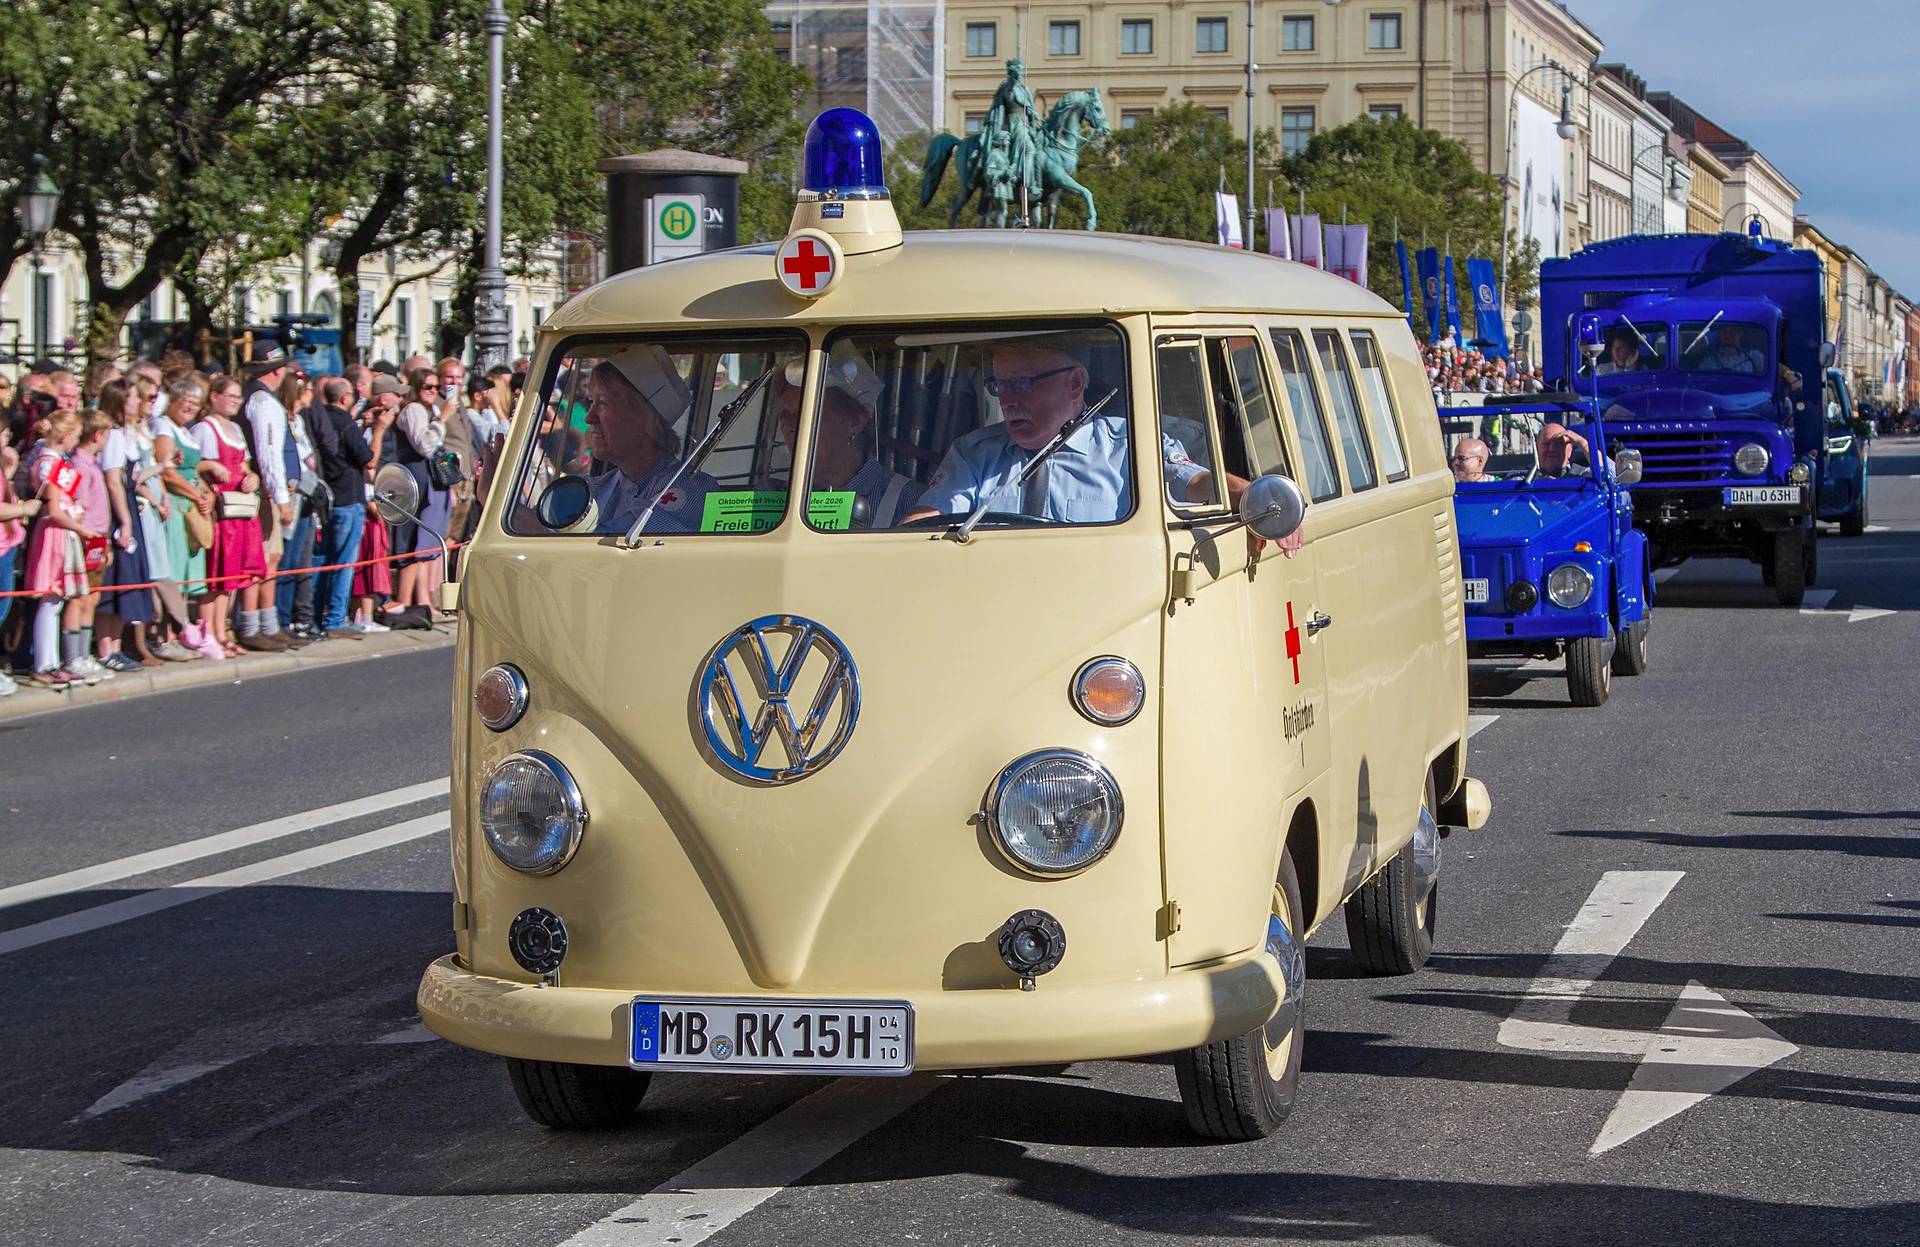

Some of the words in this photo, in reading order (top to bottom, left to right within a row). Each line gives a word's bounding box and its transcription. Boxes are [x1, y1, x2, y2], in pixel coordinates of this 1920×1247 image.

[670, 210, 685, 231] H
[718, 497, 762, 505] Oktoberfest
[1732, 490, 1753, 502] DAH
[1770, 489, 1791, 502] 63H
[713, 519, 749, 532] Freie
[1465, 582, 1475, 600] H
[880, 1016, 898, 1028] 04
[660, 1011, 708, 1055] MB
[736, 1012, 785, 1058] RK
[793, 1014, 871, 1059] 15H
[642, 1038, 651, 1050] D
[880, 1047, 898, 1059] 10
